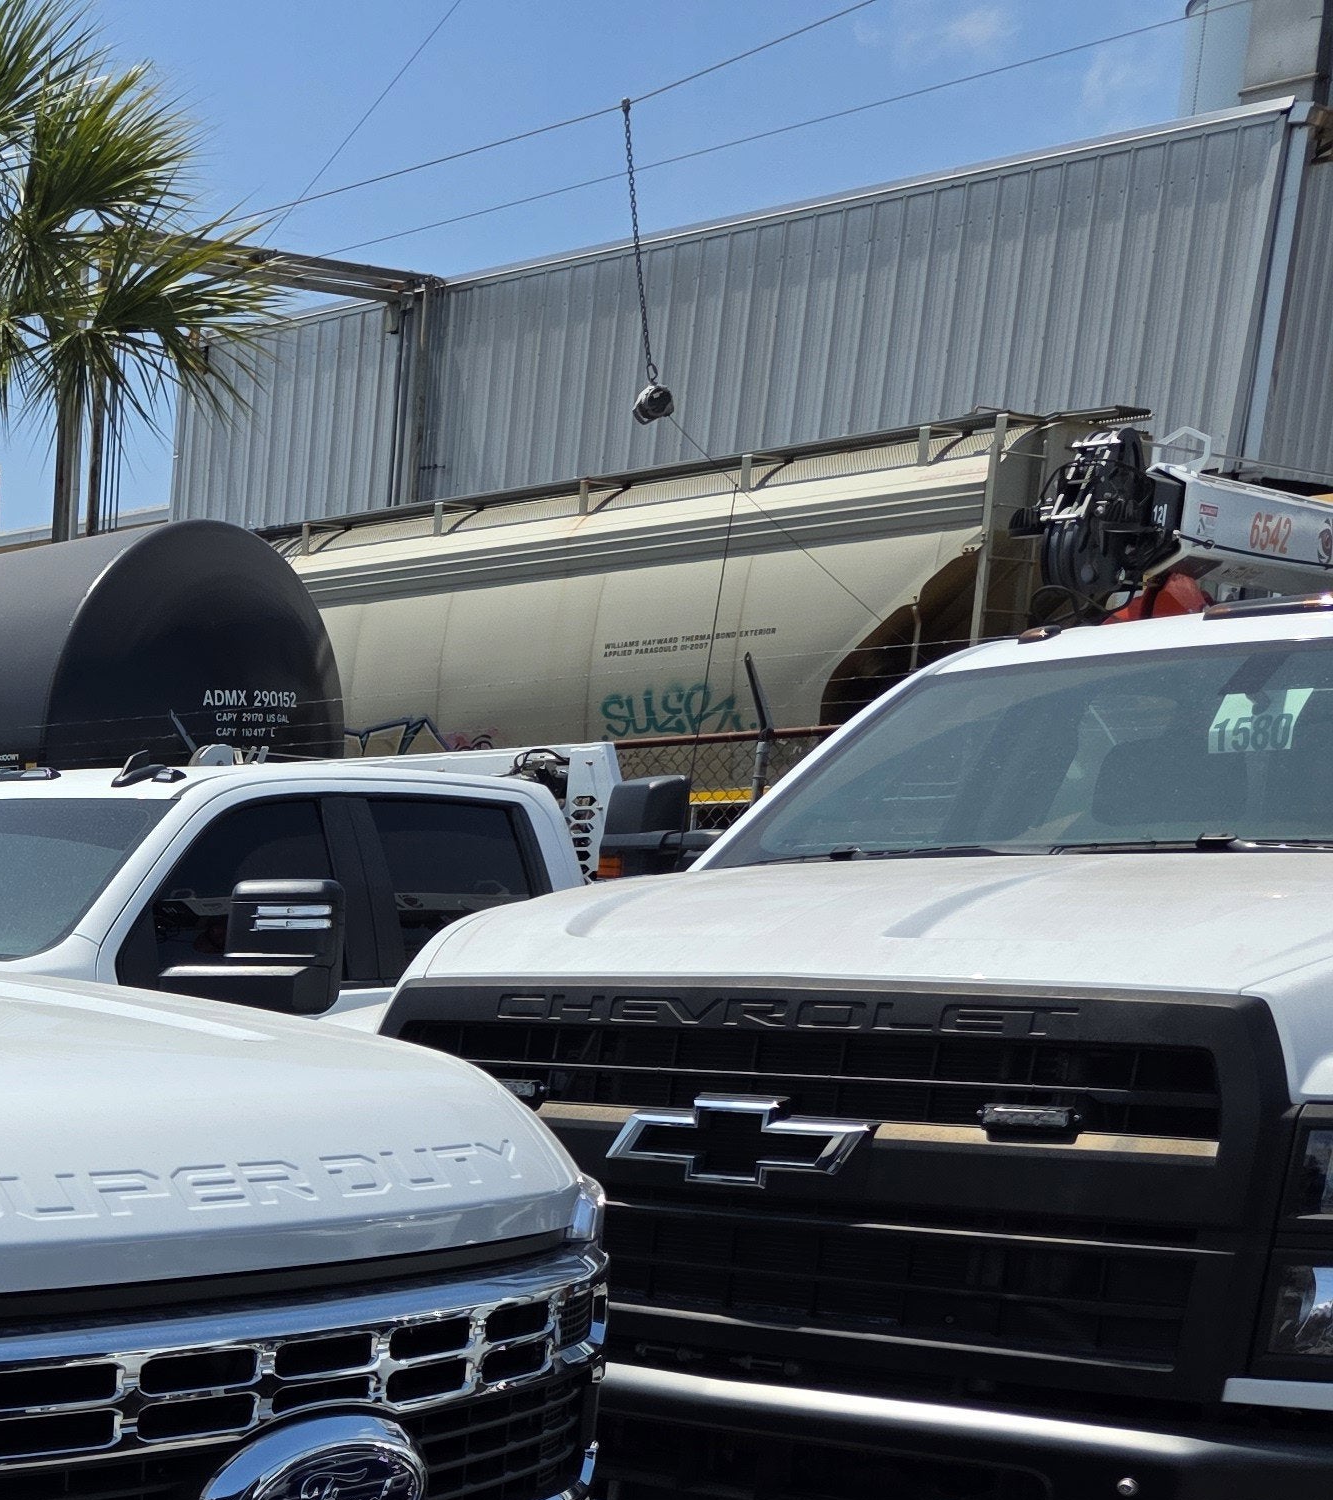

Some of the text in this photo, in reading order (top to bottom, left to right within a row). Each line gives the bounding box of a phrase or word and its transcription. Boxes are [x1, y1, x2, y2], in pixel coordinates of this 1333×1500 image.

[1249, 511, 1292, 554] 6542
[641, 636, 679, 646] HAYWARD
[739, 627, 777, 638] EXTERIOR
[603, 649, 632, 658] APPLIED
[202, 689, 298, 708] ADMX 290152
[216, 712, 290, 724] CAPY 29170 US GAL
[216, 728, 237, 737] CAPY
[1214, 713, 1294, 752] 1580
[496, 992, 1080, 1036] CHEVROLET
[317, 1138, 526, 1200] DUTY
